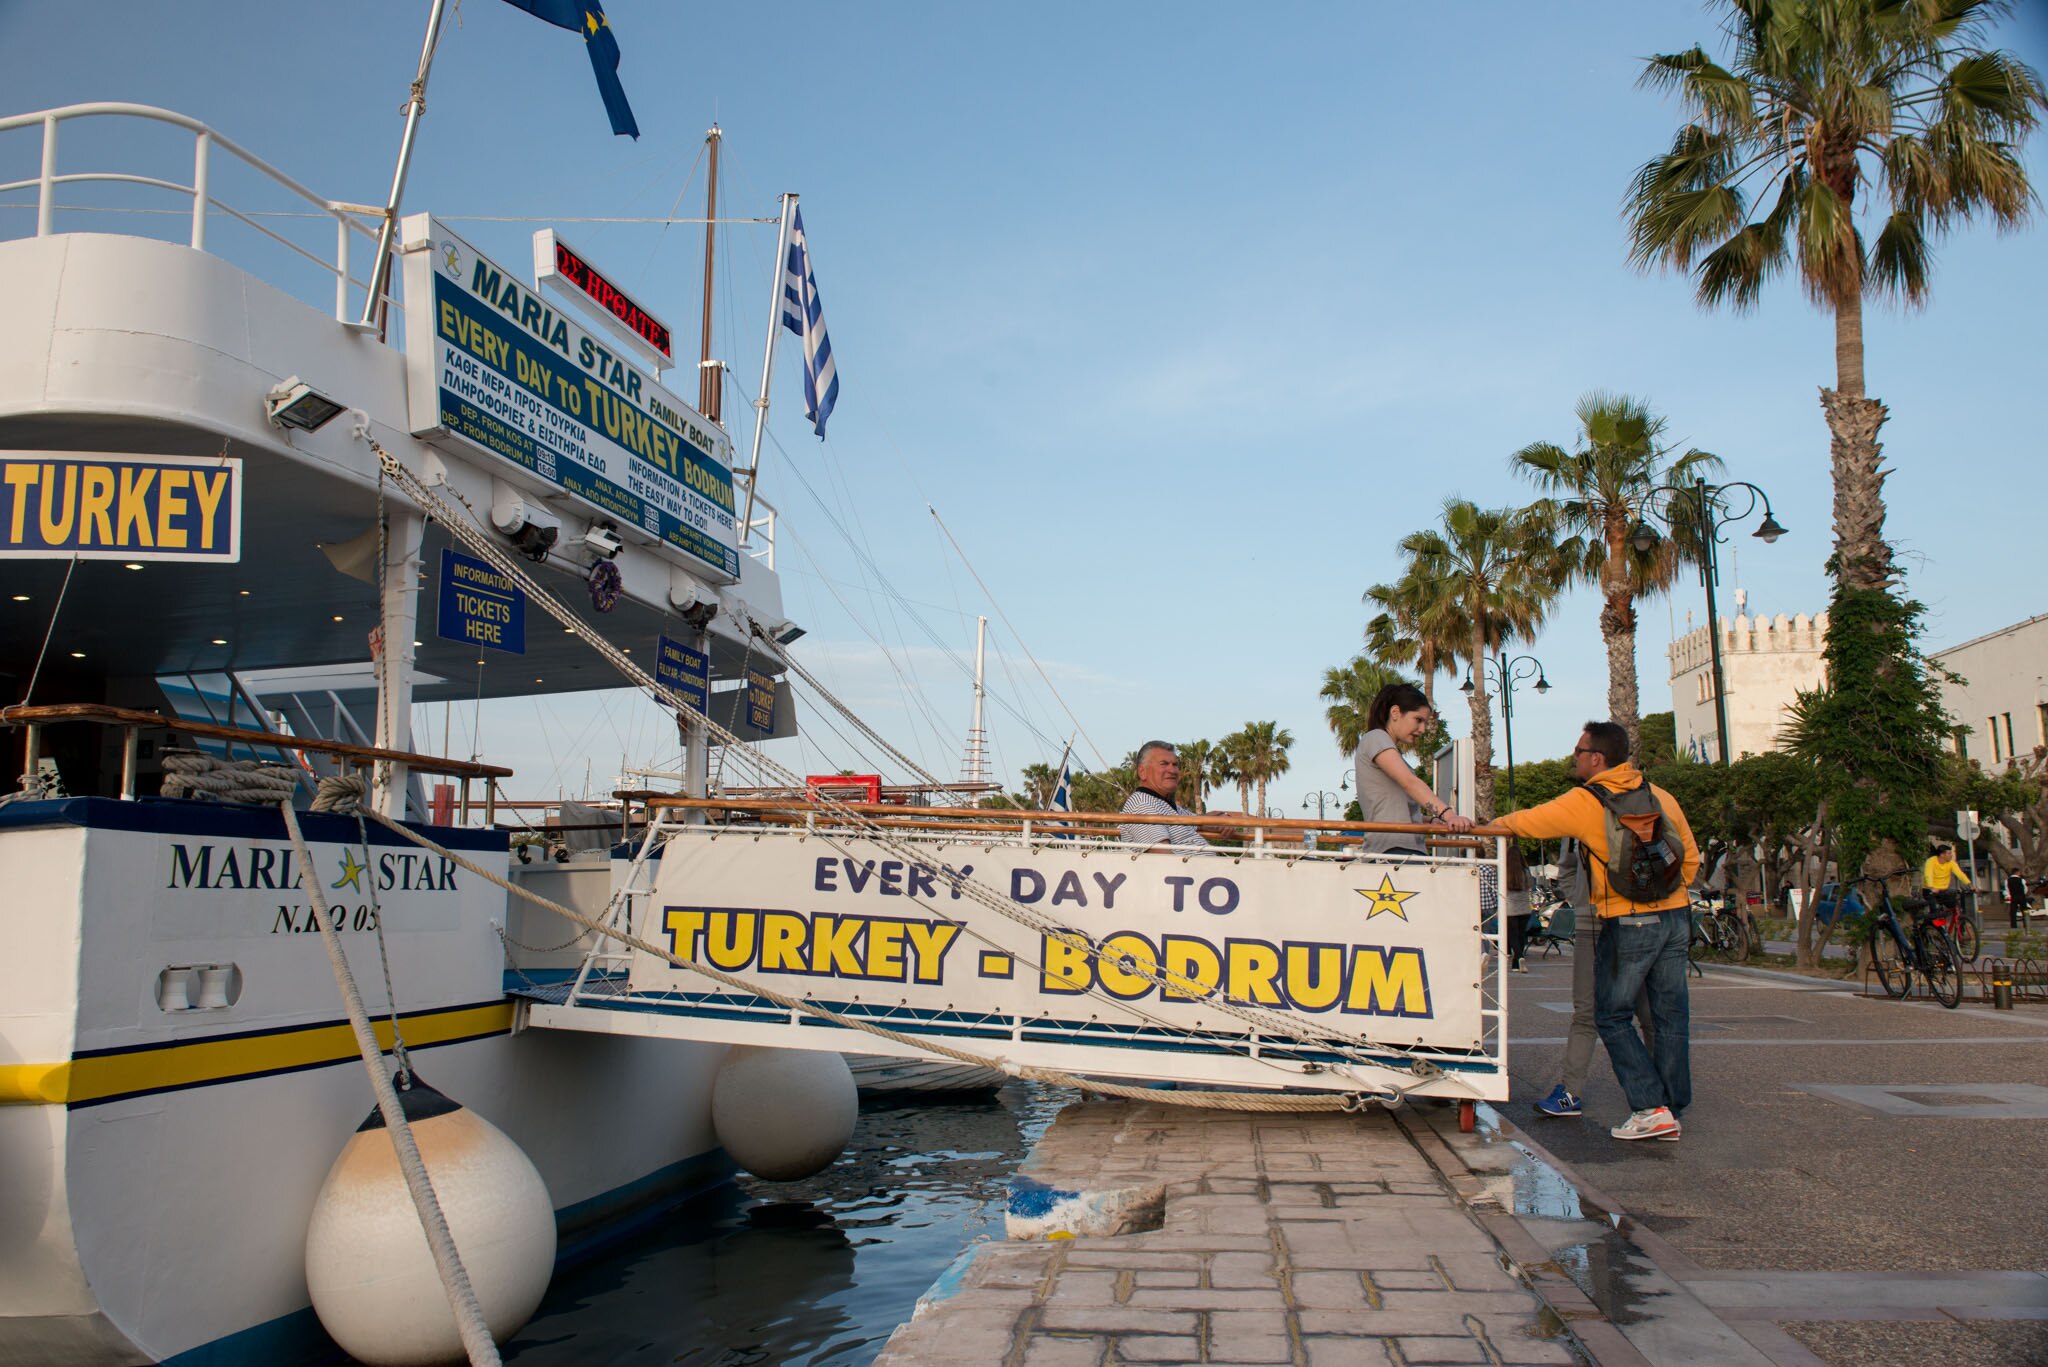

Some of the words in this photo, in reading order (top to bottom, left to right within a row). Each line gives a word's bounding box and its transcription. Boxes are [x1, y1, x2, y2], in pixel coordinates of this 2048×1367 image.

[471, 258, 570, 356] MARIA
[578, 336, 642, 404] STAR
[650, 396, 688, 435] FAMILY
[689, 424, 715, 454] BOAT
[441, 299, 510, 372] EVERY
[516, 348, 552, 398] DAY
[556, 376, 582, 416] TO
[584, 378, 679, 476] TURKEY
[684, 457, 734, 512] BODRUM
[444, 369, 525, 428] ΠΛΗΡΟΦΟΡΙΕΣ
[528, 418, 536, 434] &
[538, 424, 586, 463] ΕΙΣΙΤΗΡΙΑ
[588, 452, 607, 474] ΕΔΩ
[446, 347, 479, 380] ΚΑΘΕ
[481, 369, 512, 400] ΜΕΡΑ
[514, 390, 543, 418] ΠΡΟΣ
[545, 408, 587, 444] ΤΟΥΡΚΙΑ
[442, 409, 463, 431] DEP.
[463, 420, 488, 443] FROM
[489, 435, 524, 462] BODRUM
[524, 455, 535, 469] AT
[461, 403, 480, 424] DEP.
[481, 415, 505, 437] FROM
[506, 428, 523, 447] KOS
[523, 440, 534, 453] AT
[4, 464, 229, 549] TURKEY
[628, 457, 680, 500] INFORMATION
[681, 489, 687, 503] &
[689, 493, 716, 521] TICKETS
[717, 511, 733, 531] HERE
[628, 474, 645, 495] THE
[646, 484, 666, 508] EASY
[667, 496, 683, 519] WAY
[684, 508, 694, 522] TO
[454, 563, 514, 592] INFORMATION
[457, 593, 511, 623] TICKETS
[466, 618, 502, 643] HERE
[378, 852, 459, 891] STAR
[814, 857, 975, 900] EVERY
[1011, 868, 1128, 909] DAY
[1164, 875, 1241, 916] TO
[662, 905, 968, 986] TURKEY
[1039, 927, 1434, 1019] BODRUM
